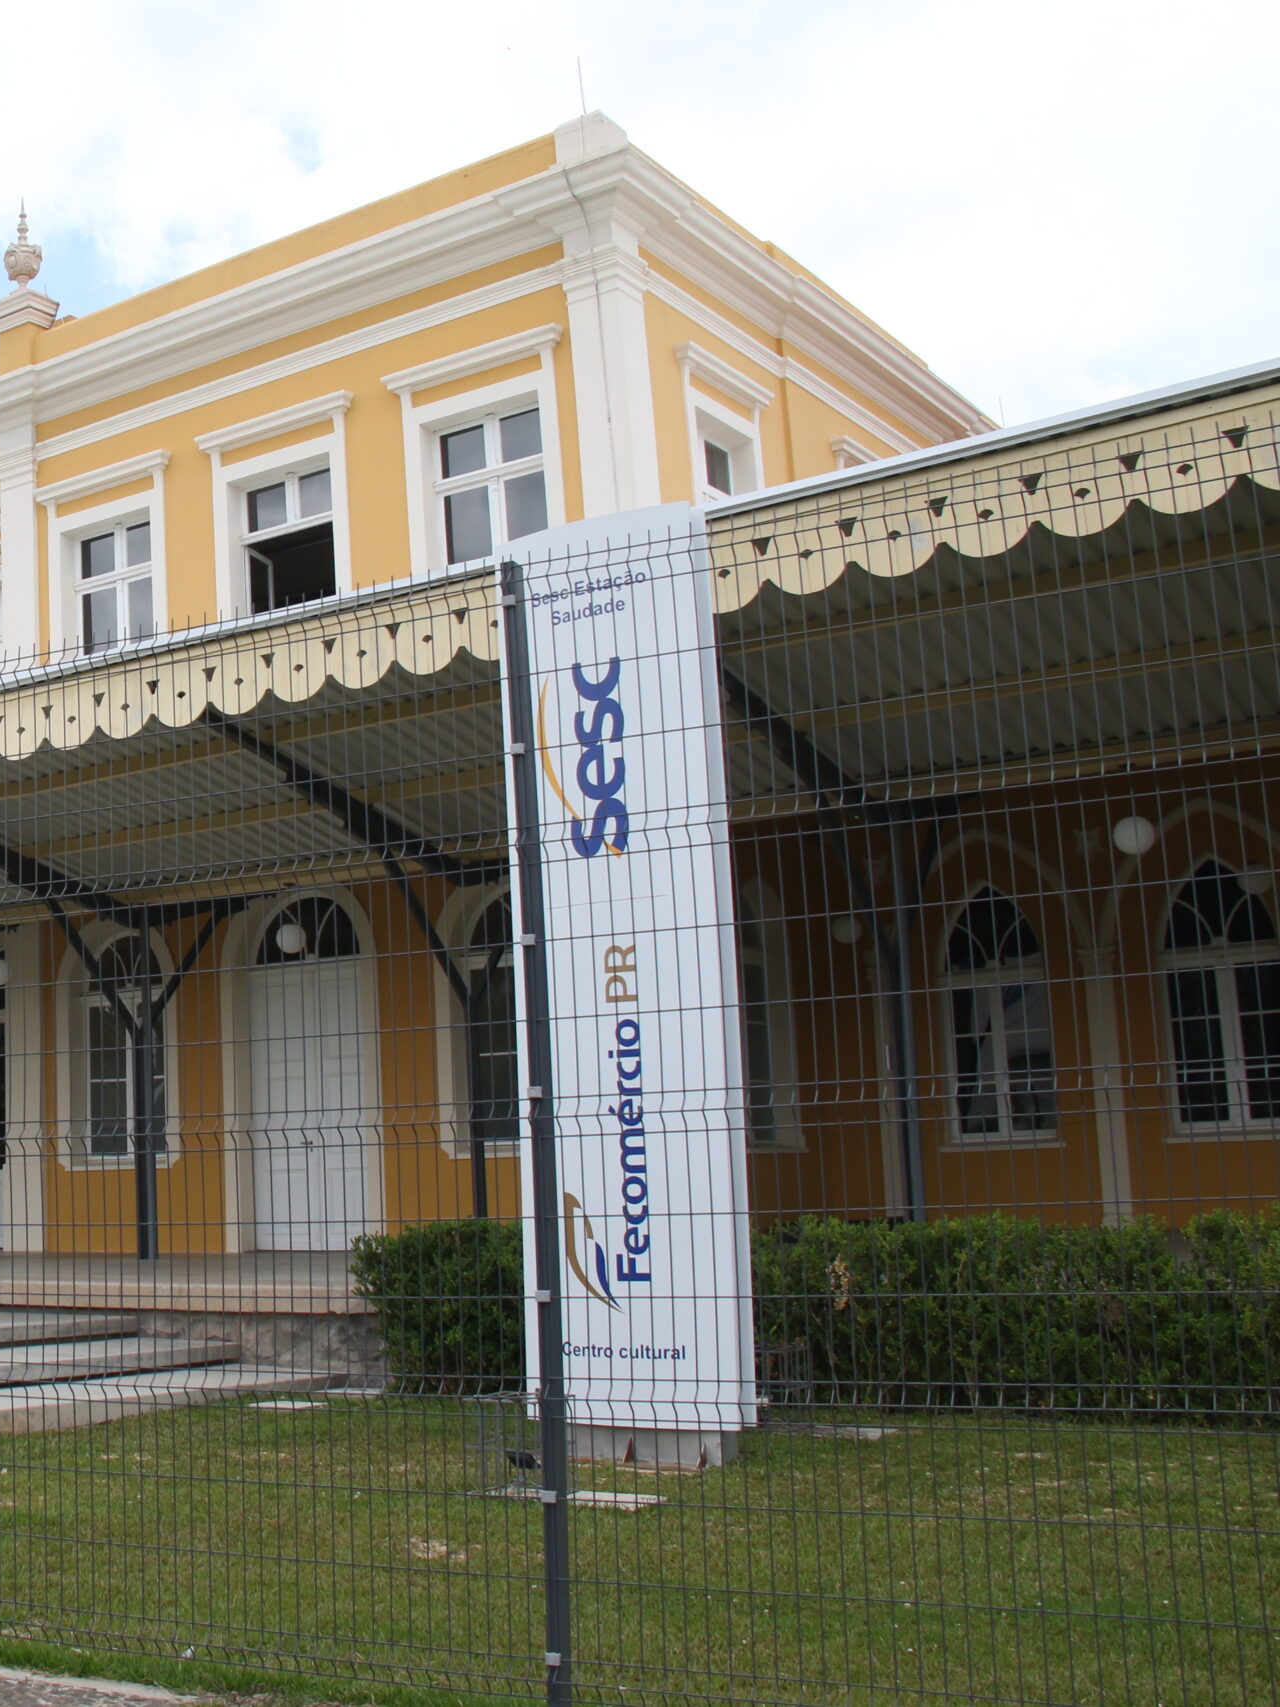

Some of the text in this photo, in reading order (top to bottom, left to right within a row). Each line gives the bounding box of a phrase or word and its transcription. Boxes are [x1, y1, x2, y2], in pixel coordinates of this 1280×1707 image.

[531, 571, 646, 608] Sesc Estação
[551, 599, 626, 626] Saudade
[604, 944, 652, 1282] Fecomércio PR
[562, 1341, 686, 1360] Centro cultural
